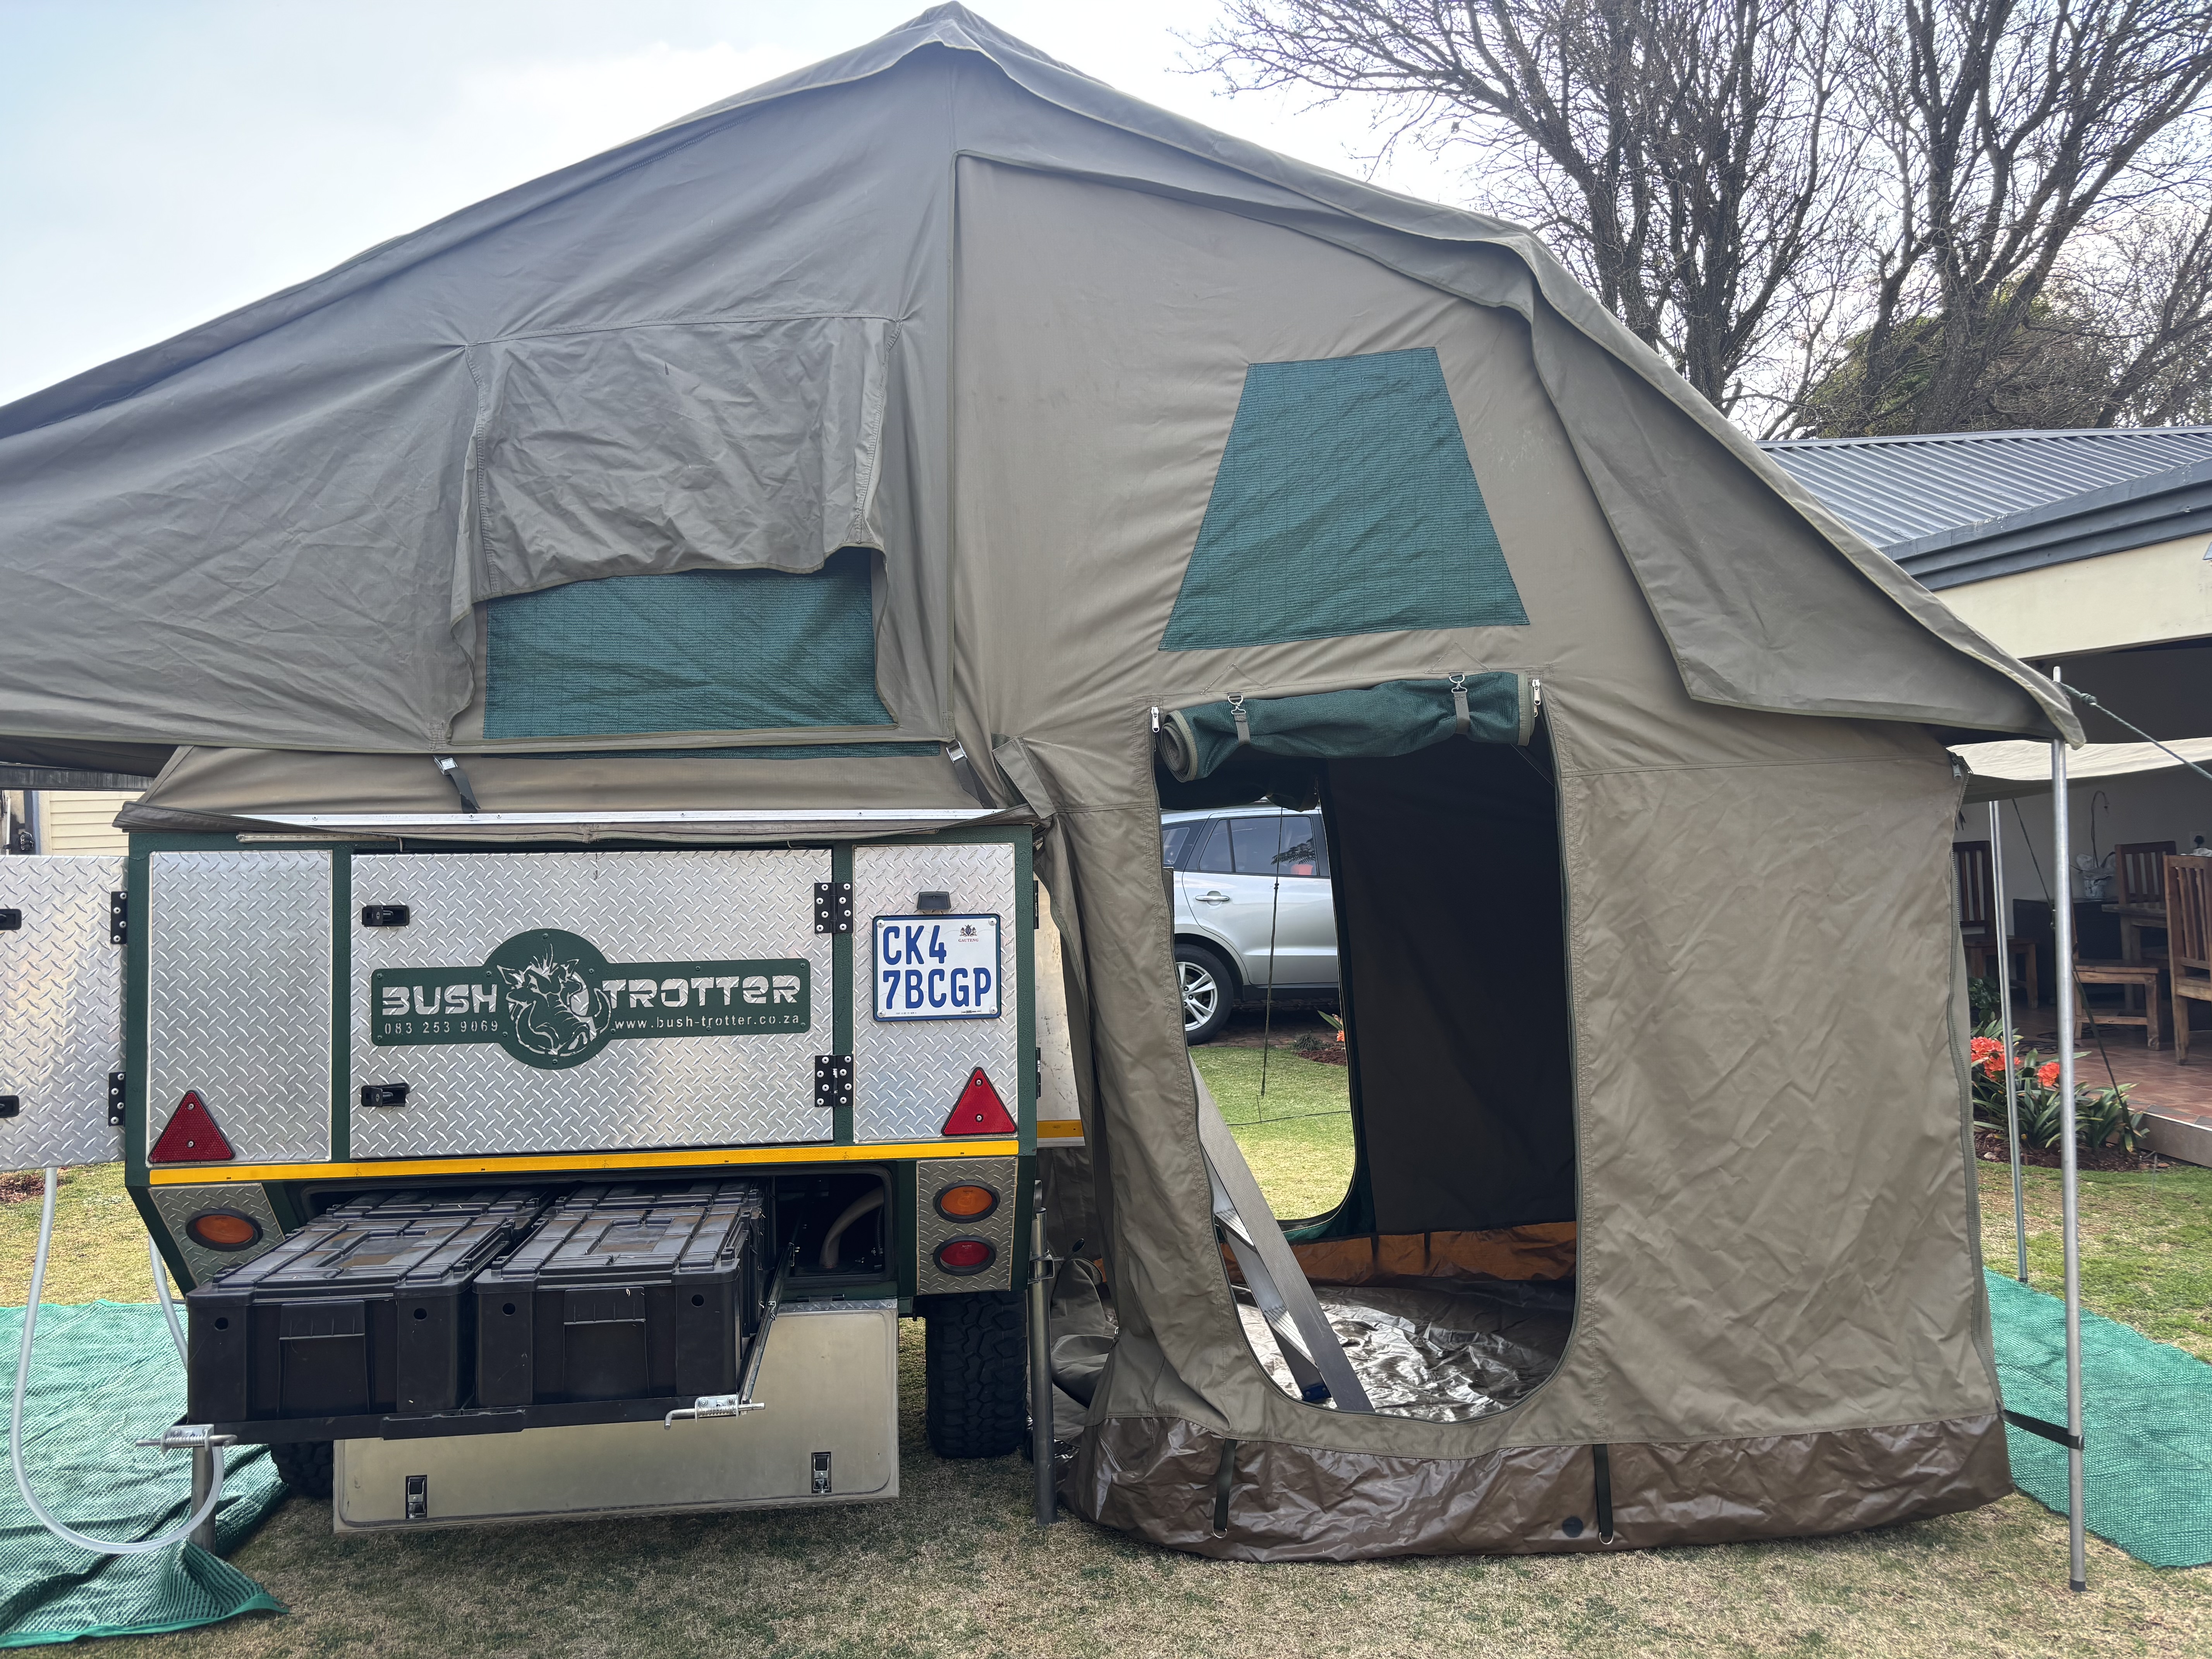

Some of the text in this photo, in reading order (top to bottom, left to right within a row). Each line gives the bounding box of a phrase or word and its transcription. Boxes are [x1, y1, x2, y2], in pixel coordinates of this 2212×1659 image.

[883, 925, 947, 965] CK4
[382, 984, 497, 1015] BUSH
[883, 967, 991, 1009] 7BCGP
[385, 1020, 498, 1034] 083 253 9069
[615, 1015, 799, 1029] www.bush-trotter.co.za
